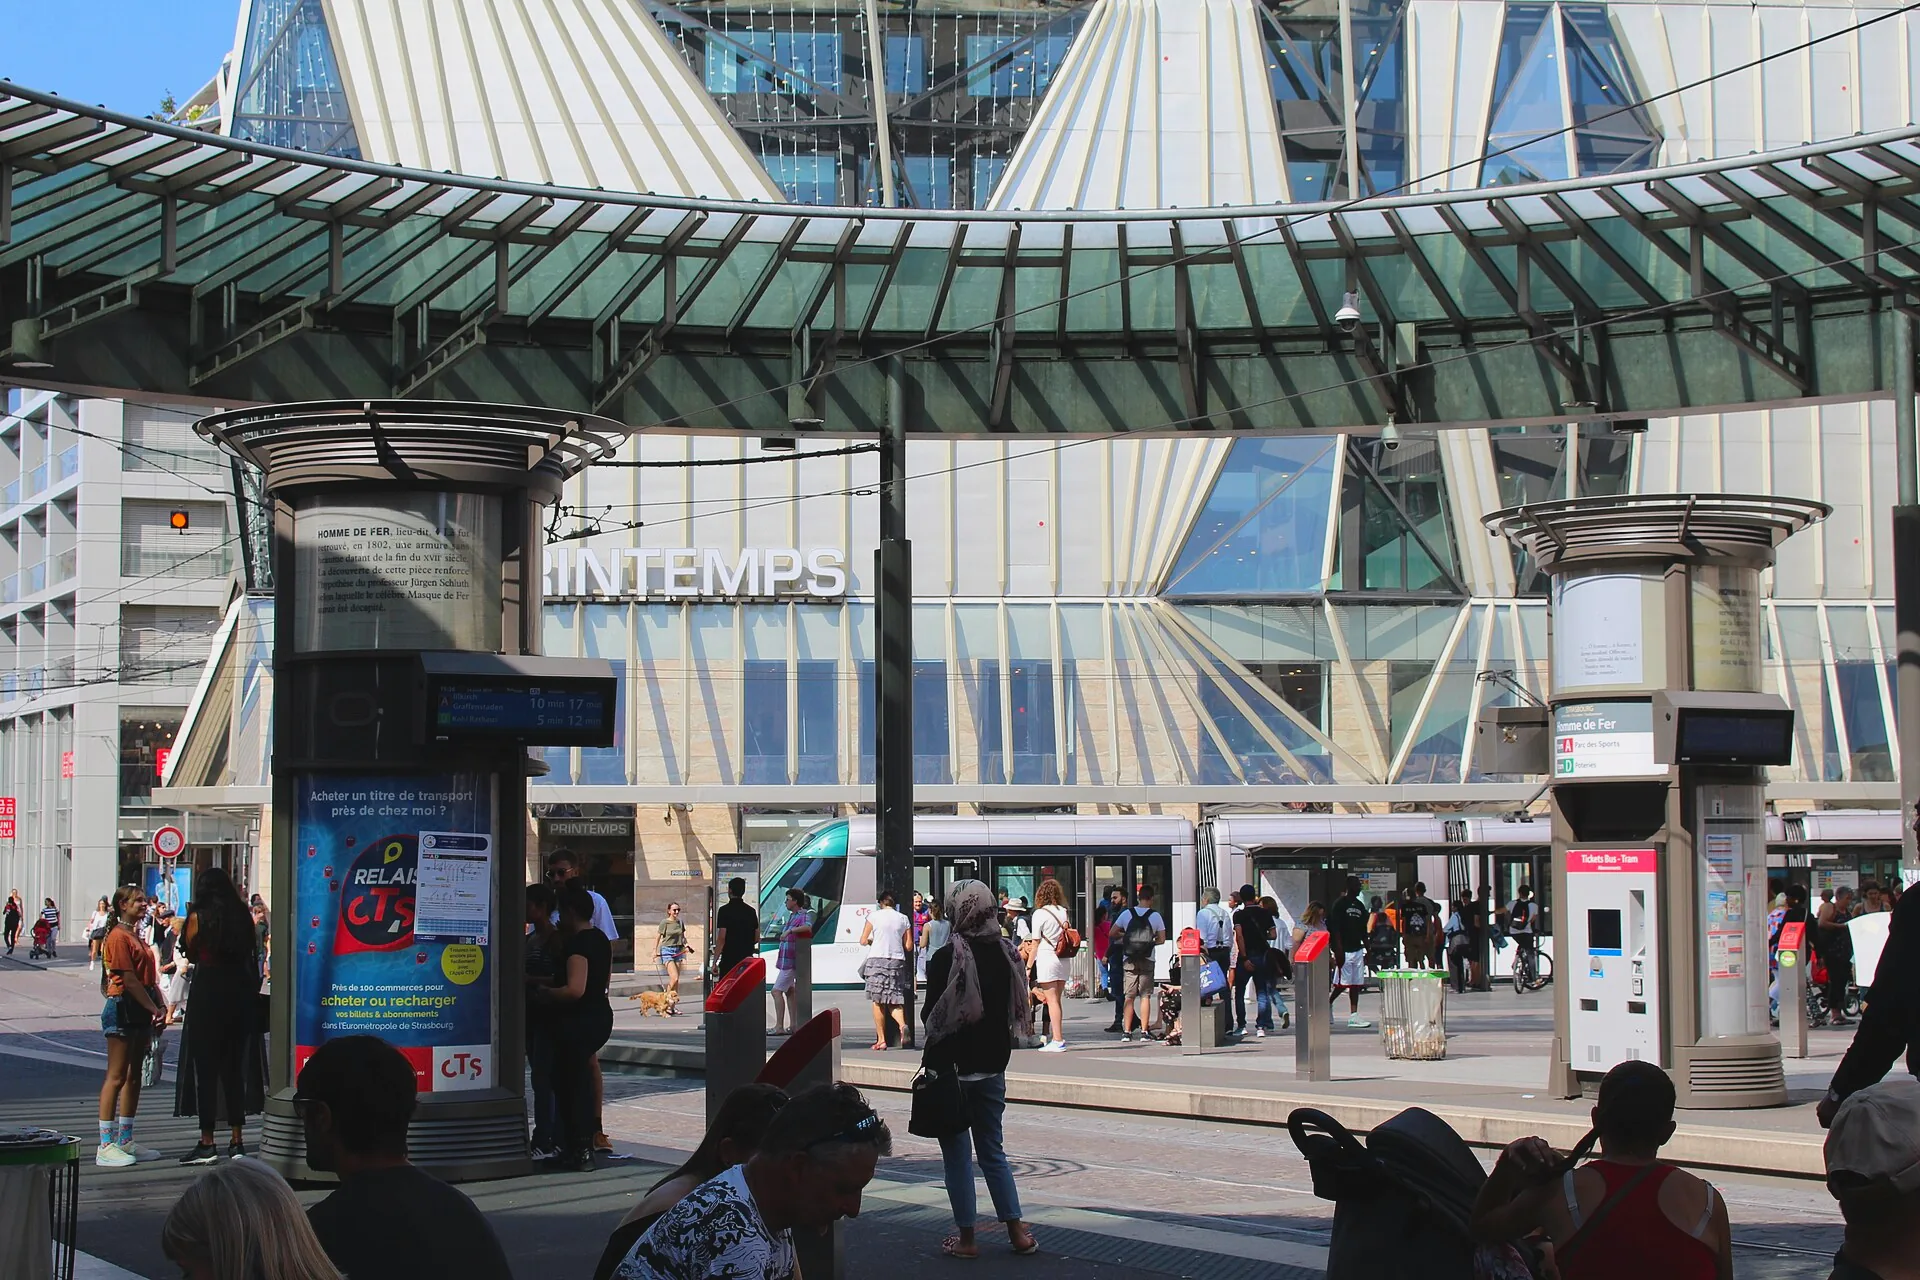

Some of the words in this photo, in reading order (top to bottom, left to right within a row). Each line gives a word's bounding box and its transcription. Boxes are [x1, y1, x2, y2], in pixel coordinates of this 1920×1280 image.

[318, 527, 350, 538] HOMME
[353, 527, 367, 537] DE
[370, 527, 393, 537] FER,
[367, 541, 391, 551] 1802,
[395, 541, 412, 549] une
[345, 554, 370, 563] datant
[373, 554, 383, 562] de
[385, 553, 393, 562] la
[395, 553, 407, 562] fin
[409, 553, 421, 562] du
[372, 566, 382, 574] de
[385, 566, 406, 574] cette
[409, 566, 432, 576] pièce
[434, 566, 469, 575] renforce
[544, 547, 846, 597] INTEMPS
[355, 579, 366, 588] du
[367, 579, 409, 588] professeur
[410, 579, 437, 589] Jürgen
[335, 590, 364, 601] laquelle
[366, 590, 374, 599] le
[407, 590, 441, 601] Masque
[443, 590, 454, 600] de
[456, 591, 469, 600] Fer
[530, 698, 545, 709] 10
[548, 700, 565, 709] min
[568, 699, 584, 710] 17
[537, 715, 545, 726] 5
[547, 716, 563, 725] min
[568, 716, 583, 726] 12
[585, 717, 602, 726] min
[1556, 720, 1582, 733] Homme
[1583, 718, 1596, 730] de
[1598, 717, 1616, 730] Fer
[1564, 739, 1572, 753] A
[1574, 741, 1586, 749] Parc
[1587, 740, 1598, 748] des
[1598, 740, 1620, 749] Sports
[1565, 759, 1573, 772] D
[310, 790, 349, 802] Acheter
[352, 791, 366, 801] un
[370, 790, 396, 801] titre
[399, 790, 415, 801] de
[418, 790, 473, 803] transport
[331, 804, 356, 817] près
[359, 804, 375, 816] de
[378, 804, 408, 816] chez
[412, 805, 436, 816] moi
[440, 805, 447, 816] ?
[550, 823, 627, 835] PRINTEMPS
[1581, 854, 1604, 864] Tickets
[1604, 854, 1617, 864] Bus
[1620, 854, 1639, 864] Tram
[347, 887, 416, 927] CTS
[839, 946, 860, 954] 2009
[331, 983, 348, 992] Près
[349, 983, 358, 991] de
[360, 984, 374, 992] 100
[375, 984, 424, 992] commerces
[425, 984, 444, 993] pour
[321, 995, 367, 1007] acheter
[369, 997, 387, 1007] ou
[390, 995, 457, 1009] recharger
[349, 1010, 374, 1019] billets
[375, 1010, 381, 1018] &
[382, 1010, 439, 1019] abonnements
[321, 1022, 338, 1030] dans
[338, 1021, 398, 1031] l'Eurométropole
[399, 1022, 410, 1030] de
[441, 1053, 482, 1079] CTS
